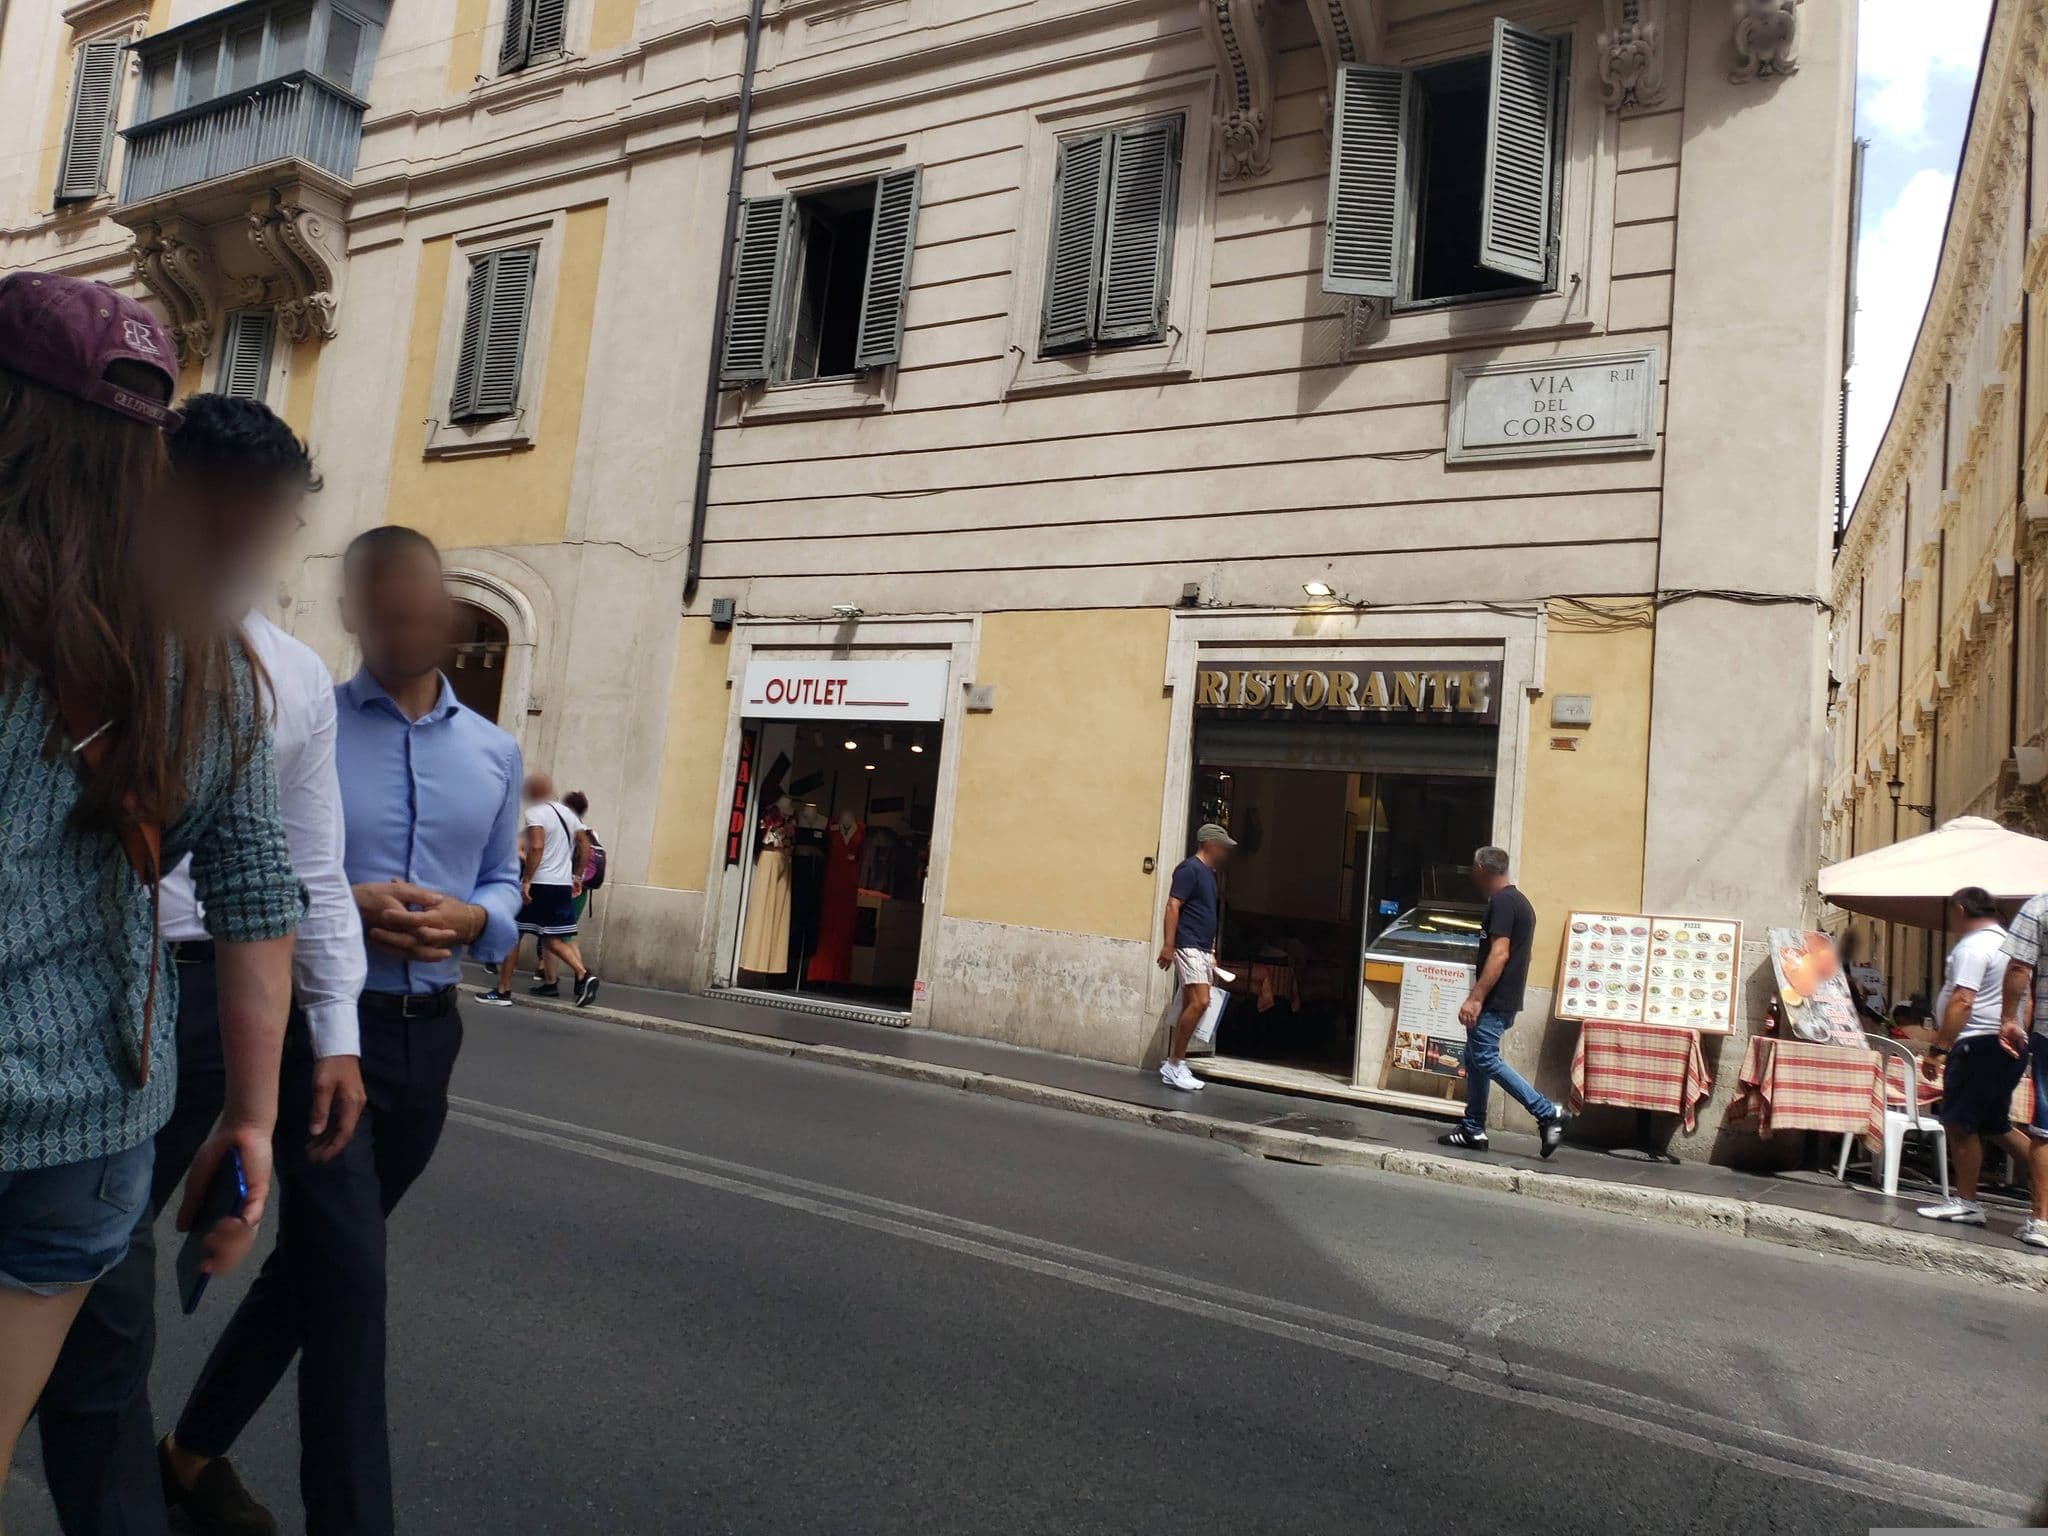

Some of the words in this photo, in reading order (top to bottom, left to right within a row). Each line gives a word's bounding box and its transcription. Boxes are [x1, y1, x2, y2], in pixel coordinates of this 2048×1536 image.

[1529, 375, 1574, 394] VIA
[1534, 399, 1568, 413] DEL
[1503, 413, 1595, 437] CORSO
[765, 678, 848, 705] OUTLET
[1196, 669, 1490, 713] RISTORANTE
[728, 735, 752, 860] SALDI
[1416, 964, 1465, 979] Caffetteria
